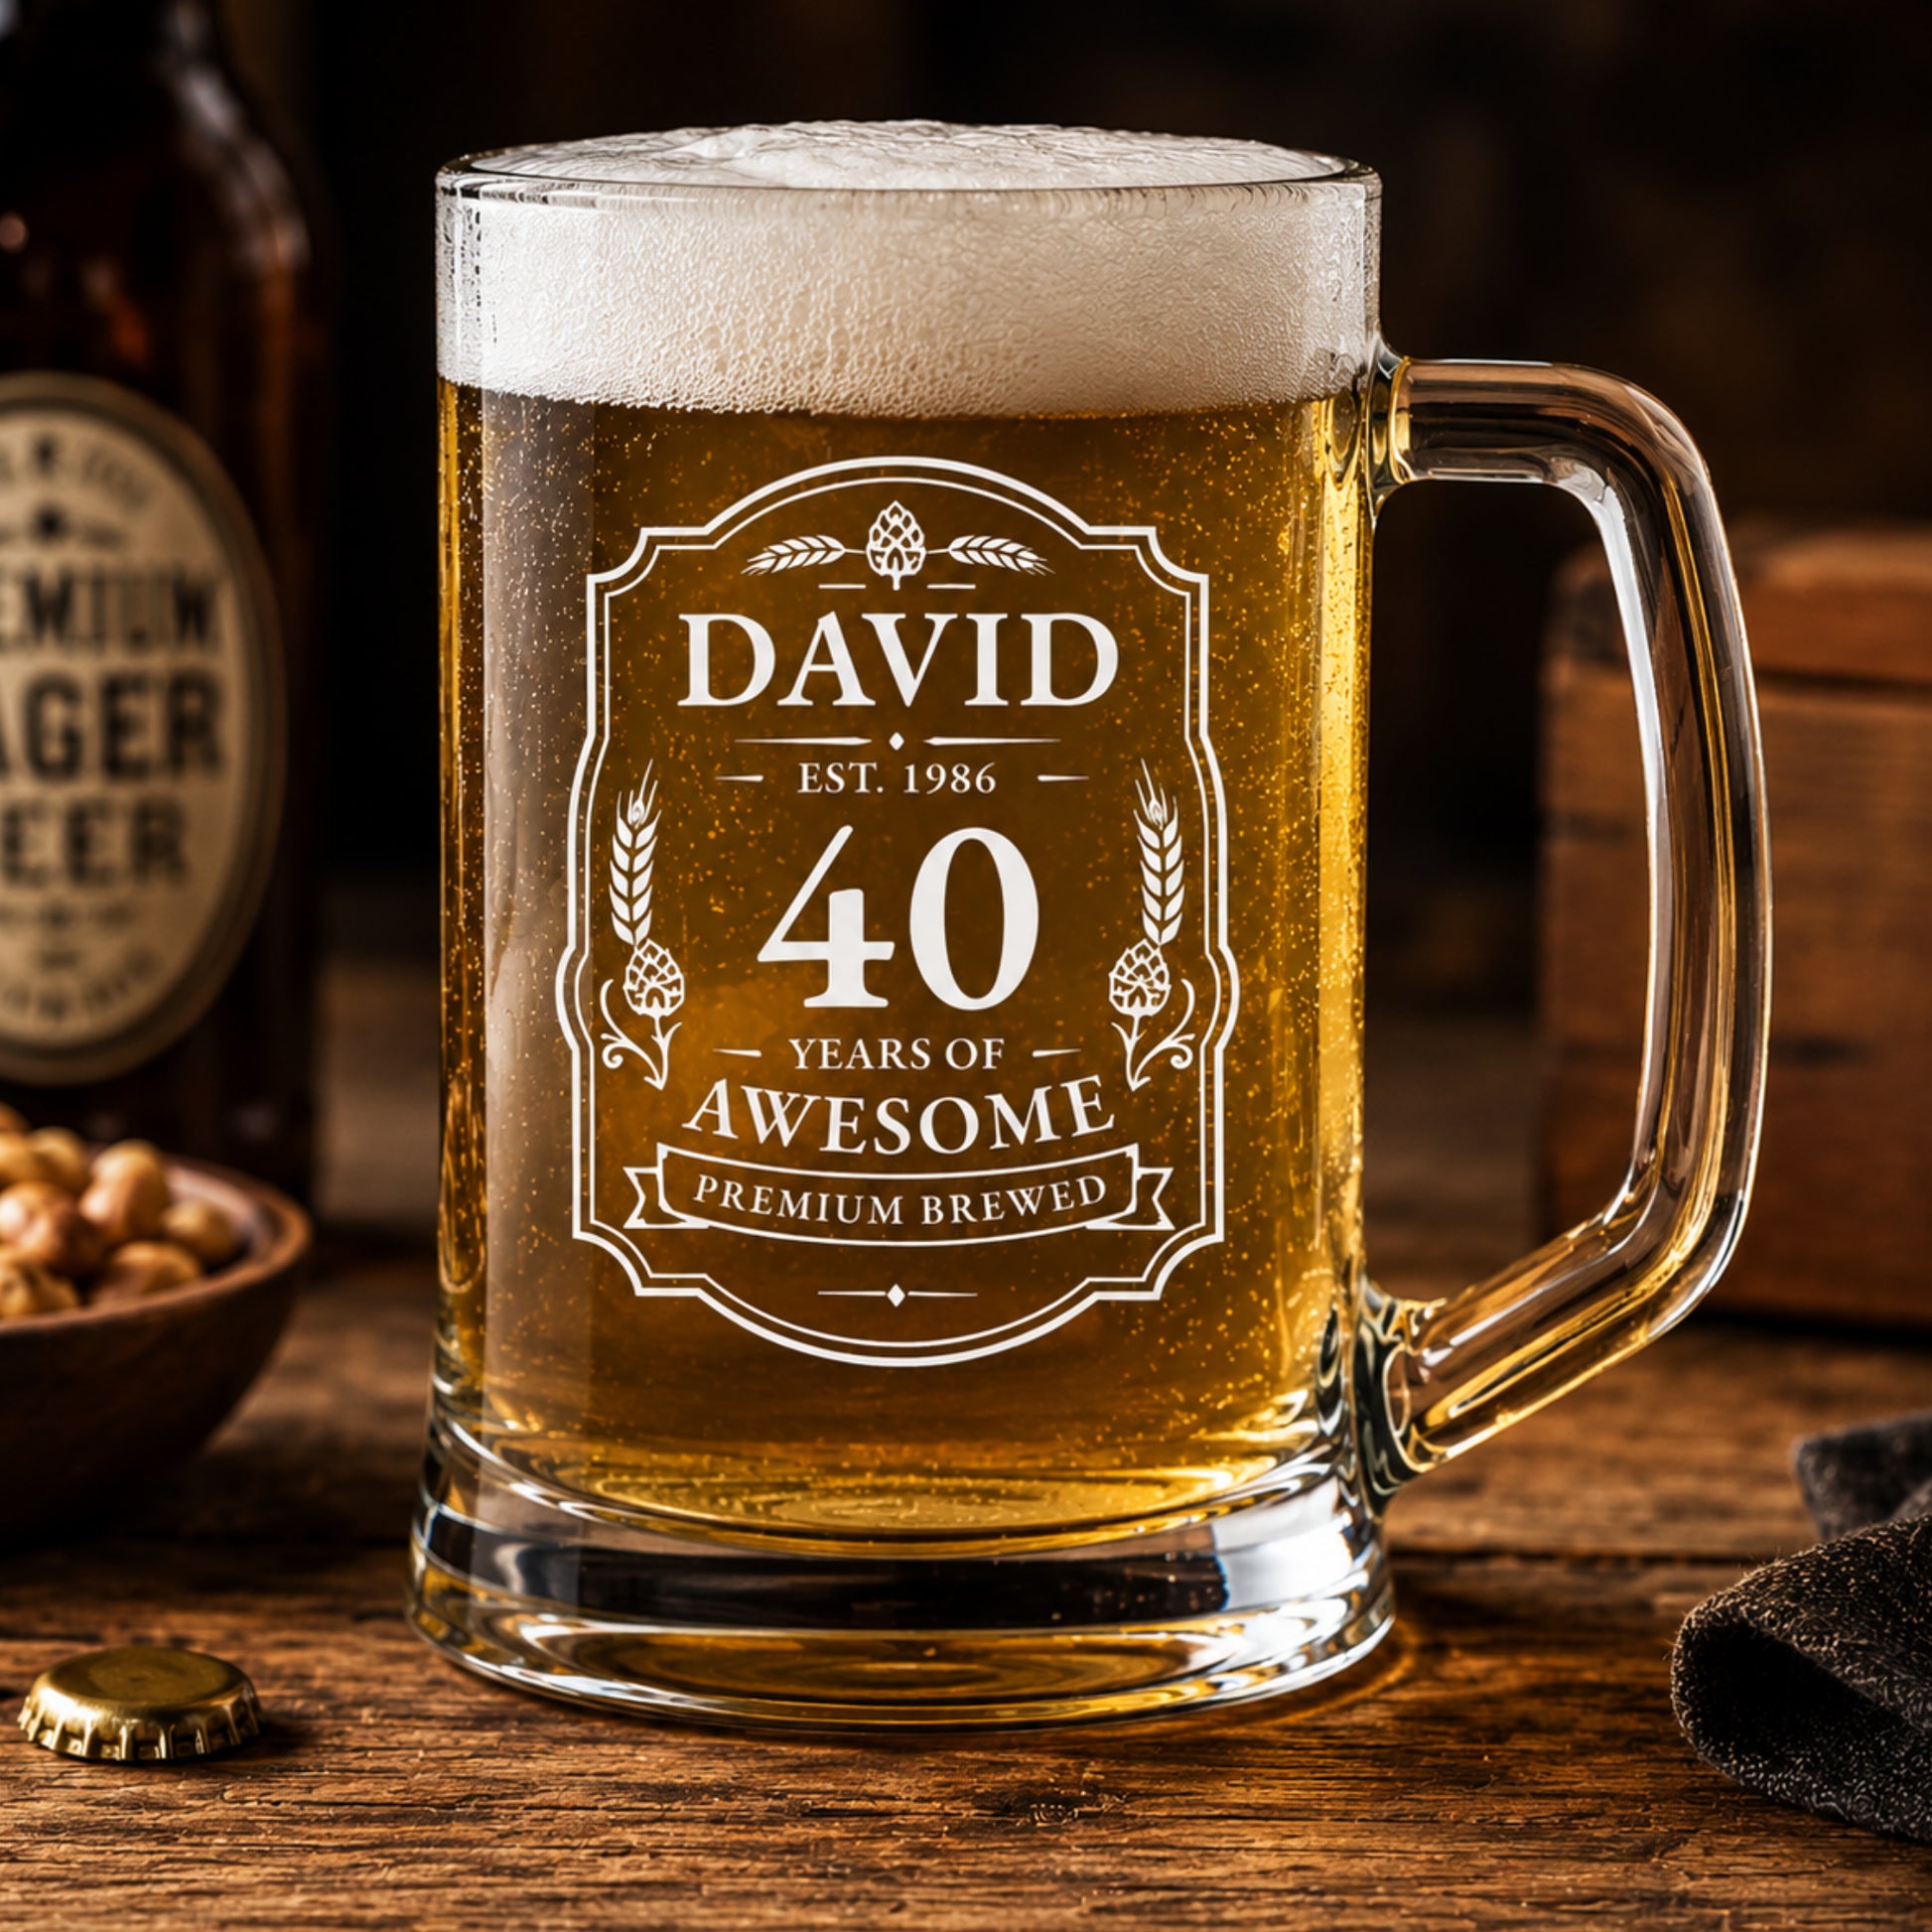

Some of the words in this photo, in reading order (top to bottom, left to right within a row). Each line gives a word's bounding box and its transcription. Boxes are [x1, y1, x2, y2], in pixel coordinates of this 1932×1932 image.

[678, 612, 1119, 706] DAVID
[0, 672, 224, 782] GER
[798, 762, 884, 793] EST.
[905, 763, 996, 794] 1986
[757, 825, 1039, 1011] 40
[788, 1038, 931, 1070] YEARS
[945, 1038, 1005, 1070] OF
[681, 1075, 1115, 1155] AWESOME
[693, 1175, 902, 1224] PREMIUM
[921, 1175, 1106, 1225] BREWED
